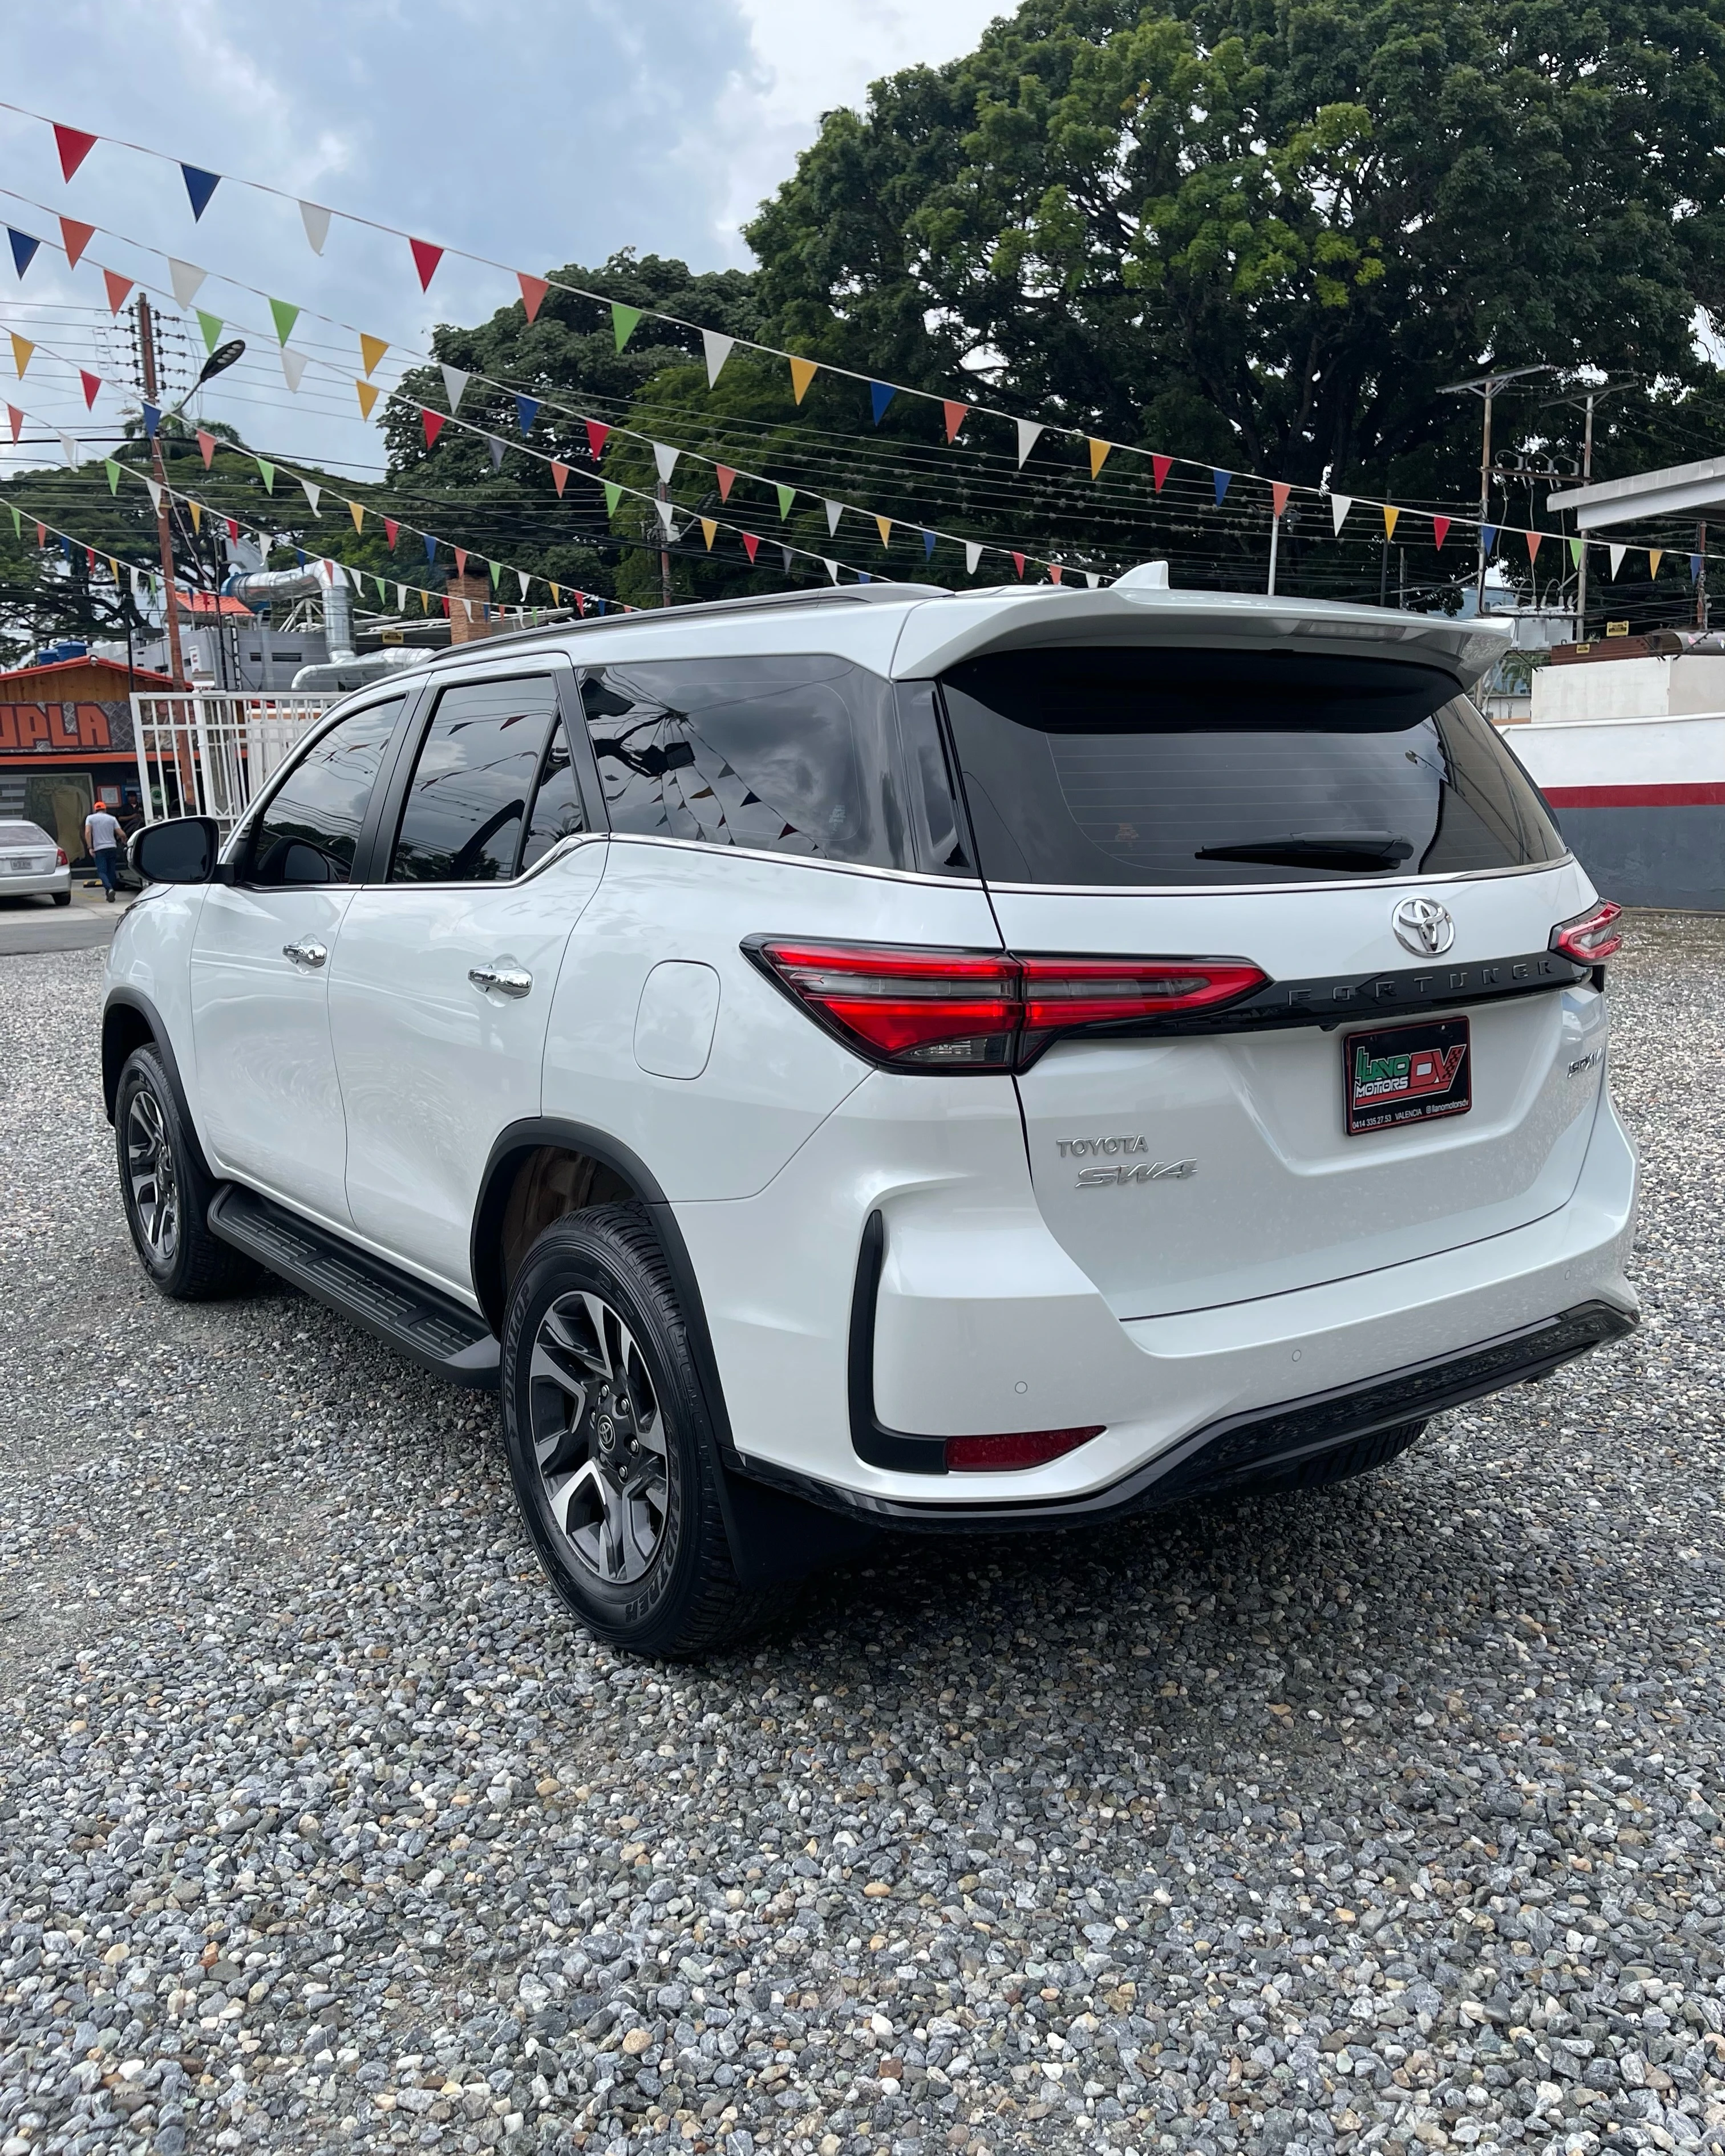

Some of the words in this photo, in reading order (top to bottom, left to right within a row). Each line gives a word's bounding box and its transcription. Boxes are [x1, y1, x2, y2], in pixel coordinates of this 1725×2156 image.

[1289, 960, 1554, 1006] FORTUNER
[1355, 1077, 1408, 1097] MOTORS
[1366, 1115, 1392, 1127] 335.27.53
[1395, 1108, 1422, 1120] VALENCIA
[1056, 1134, 1148, 1157] TOYOTA
[1075, 1158, 1198, 1188] SW4
[505, 1282, 530, 1412] DUNLOP
[626, 1411, 681, 1622] GRANDTREK
